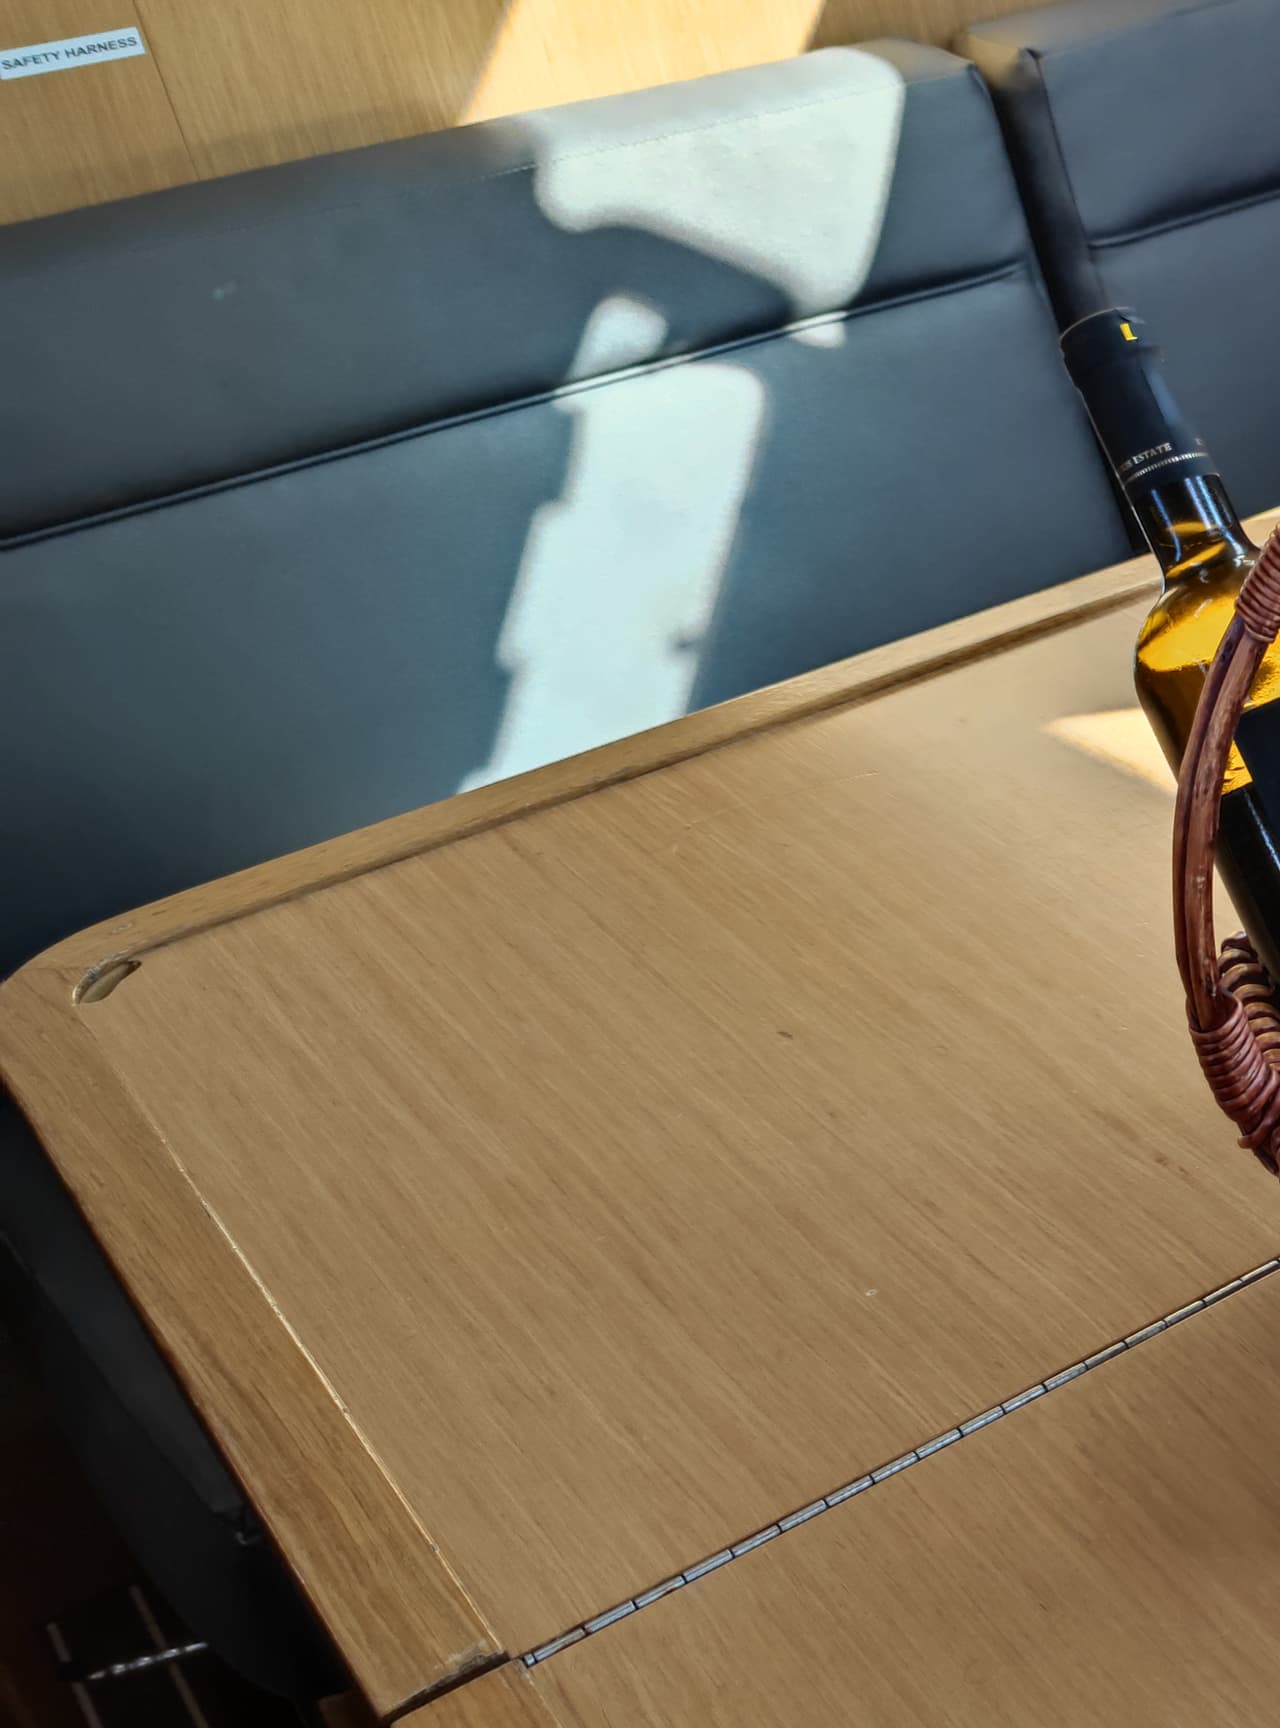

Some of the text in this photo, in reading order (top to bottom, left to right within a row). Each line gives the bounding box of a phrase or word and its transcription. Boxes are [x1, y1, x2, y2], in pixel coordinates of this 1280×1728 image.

[1, 36, 138, 71] SAFETY HARNESS
[1131, 441, 1173, 465] ESTATE
